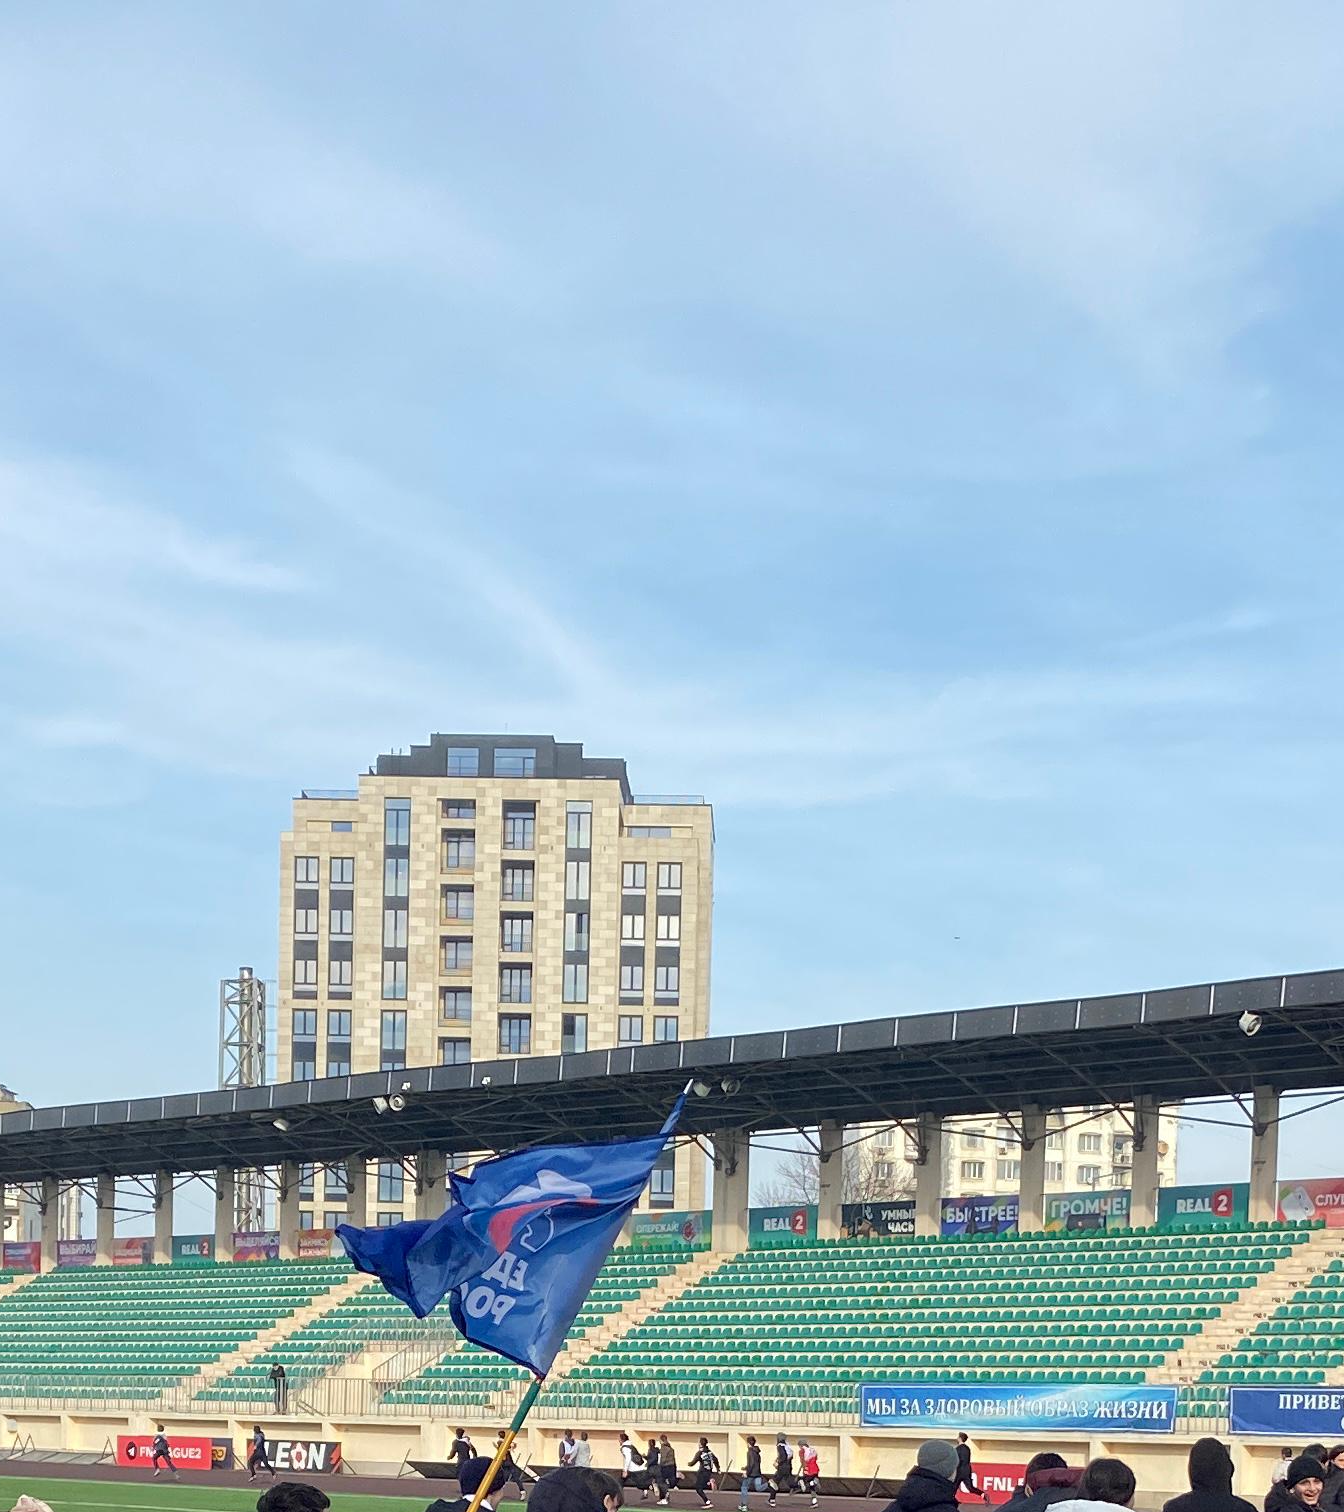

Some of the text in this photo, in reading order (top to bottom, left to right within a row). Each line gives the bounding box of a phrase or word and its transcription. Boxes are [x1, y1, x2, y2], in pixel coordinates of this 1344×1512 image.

[1051, 1197, 1128, 1218] ГРОМЧЕ!
[1176, 1194, 1228, 1213] REAL 2
[764, 1215, 804, 1231] REAL 2
[945, 1205, 1019, 1223] БЫСТРЕЕ!
[867, 1395, 1168, 1421] МЫ ЗА ЗДОРОВЫЙ ОБРАЗ ЖИЗНИ
